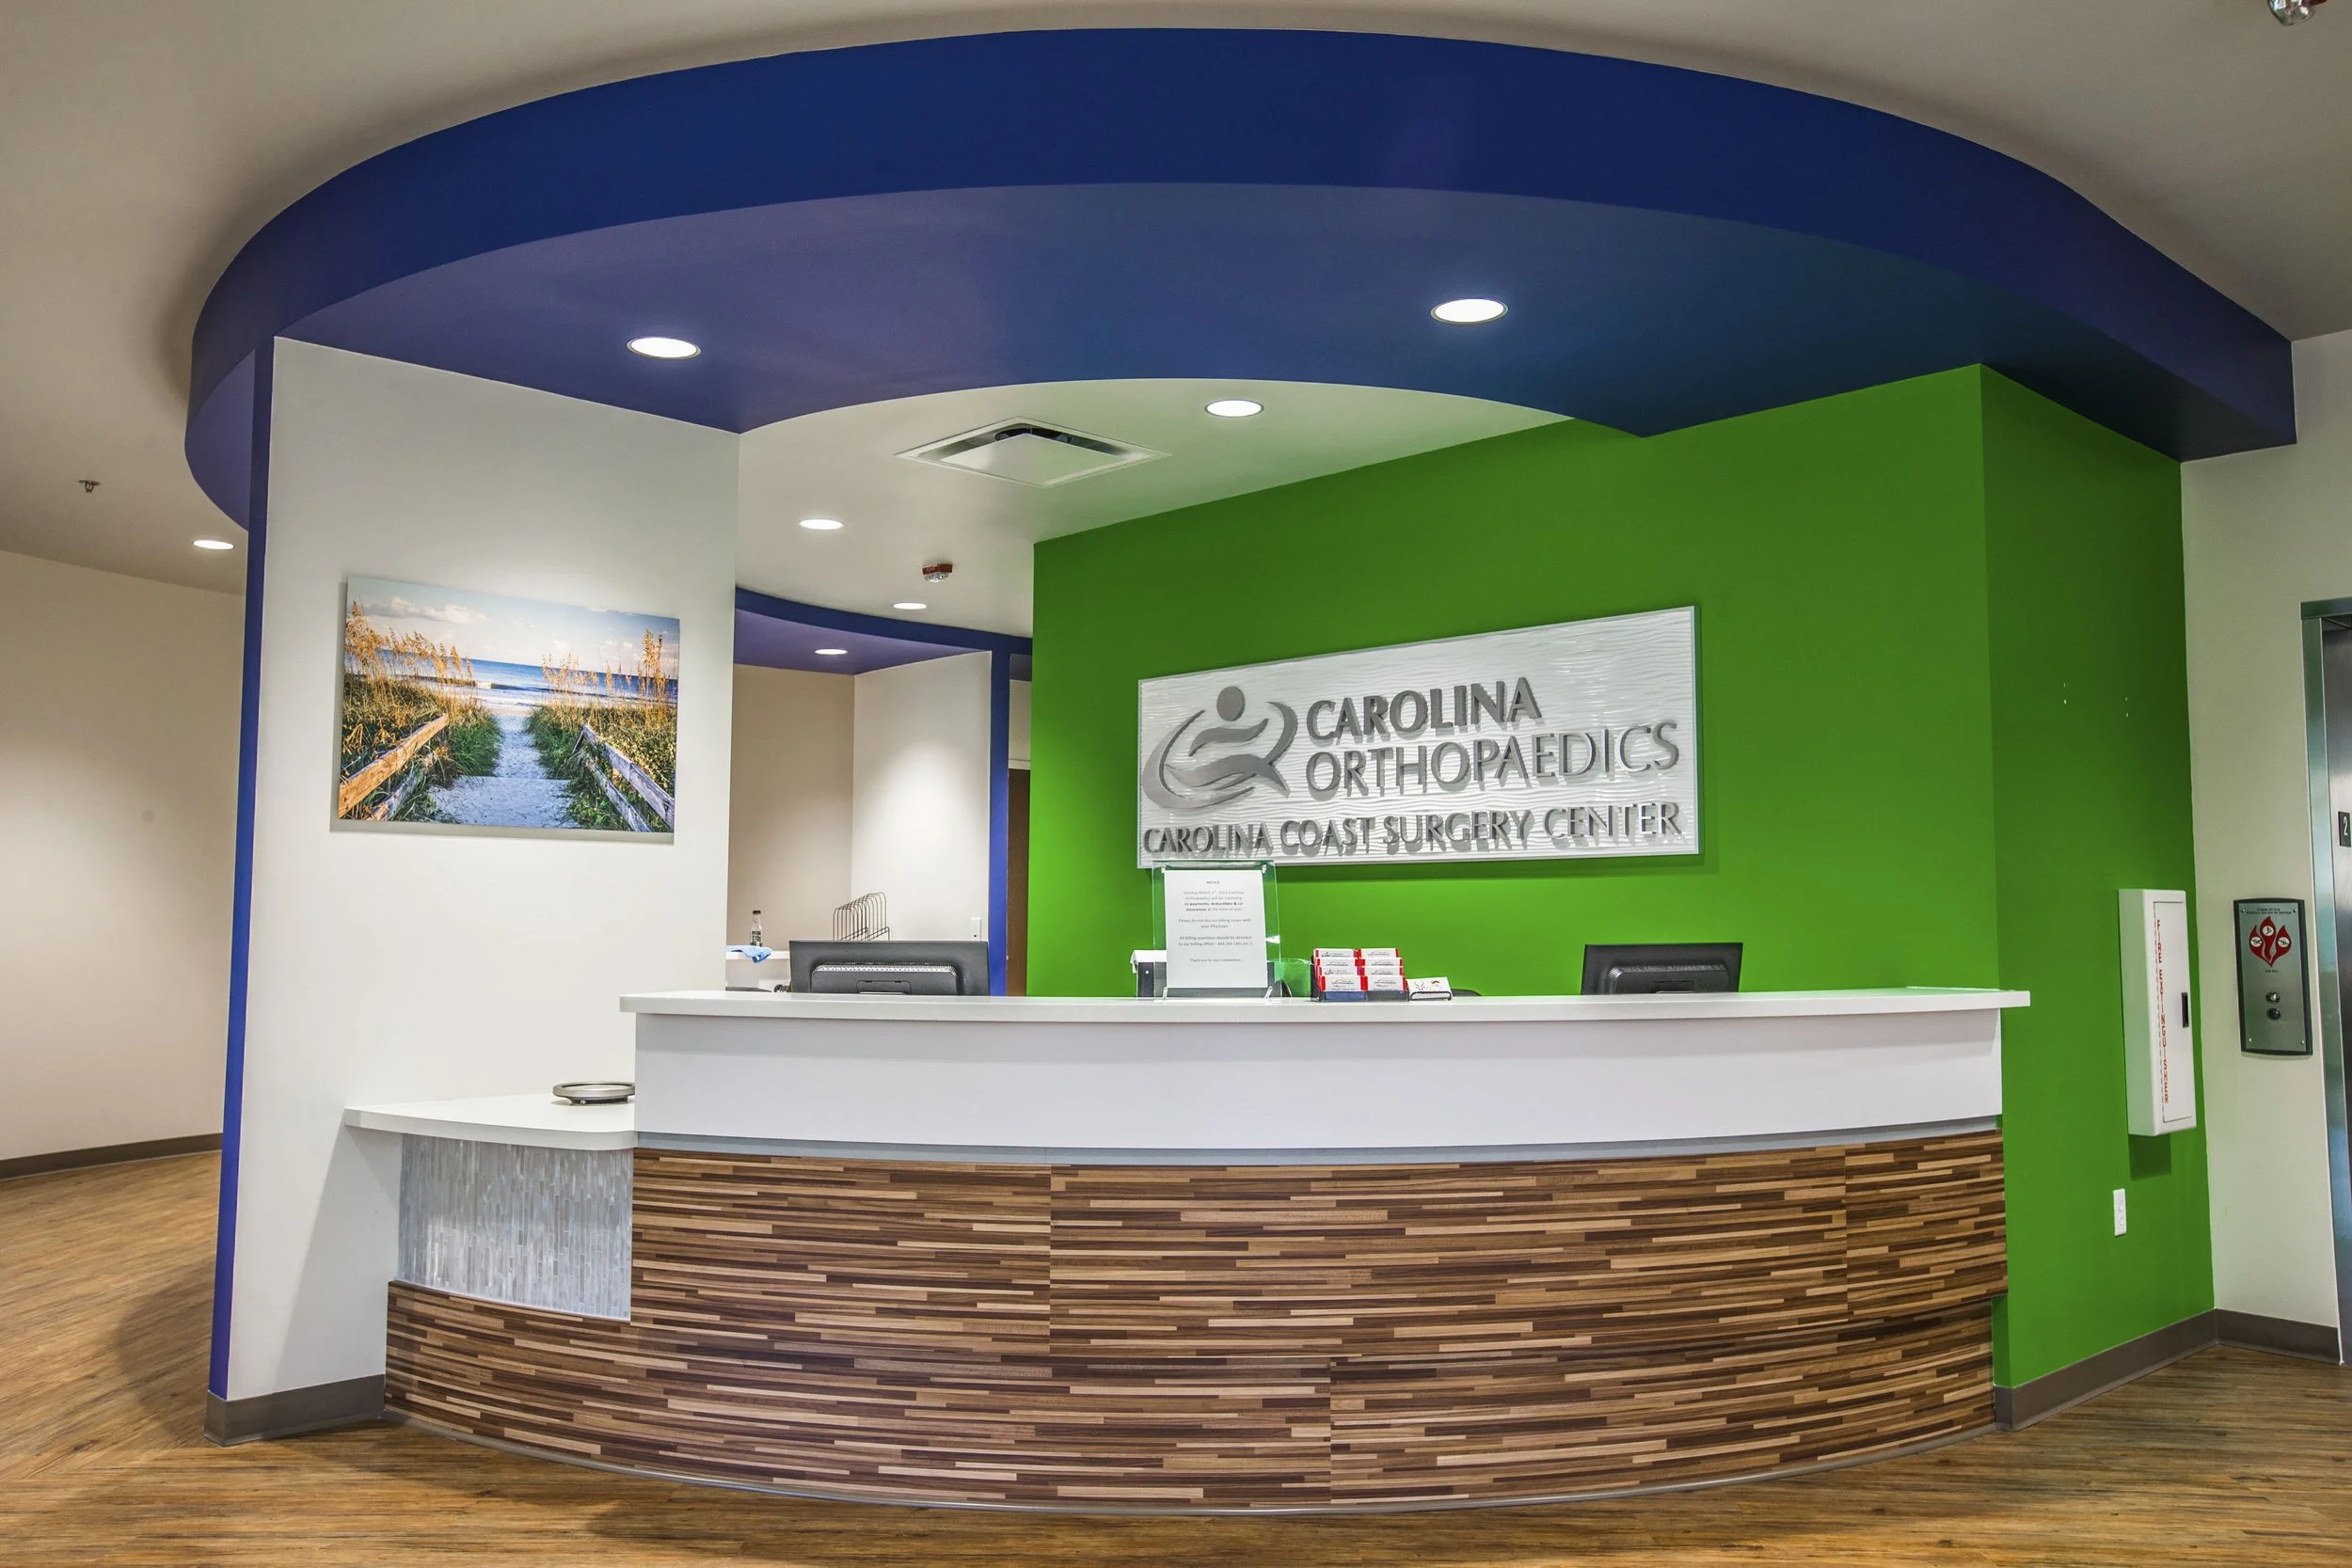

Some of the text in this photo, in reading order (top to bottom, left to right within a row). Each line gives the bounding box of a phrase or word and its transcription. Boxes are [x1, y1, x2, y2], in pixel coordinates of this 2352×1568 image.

[1306, 676, 1542, 740] CAROLINA
[1306, 721, 1680, 792] ORTHOPAEDICS
[1143, 802, 1682, 853] CAROLINA COAST SURGERY CENTER
[2343, 816, 2349, 836] 2
[2158, 969, 2169, 1104] EXTINGUISHER
